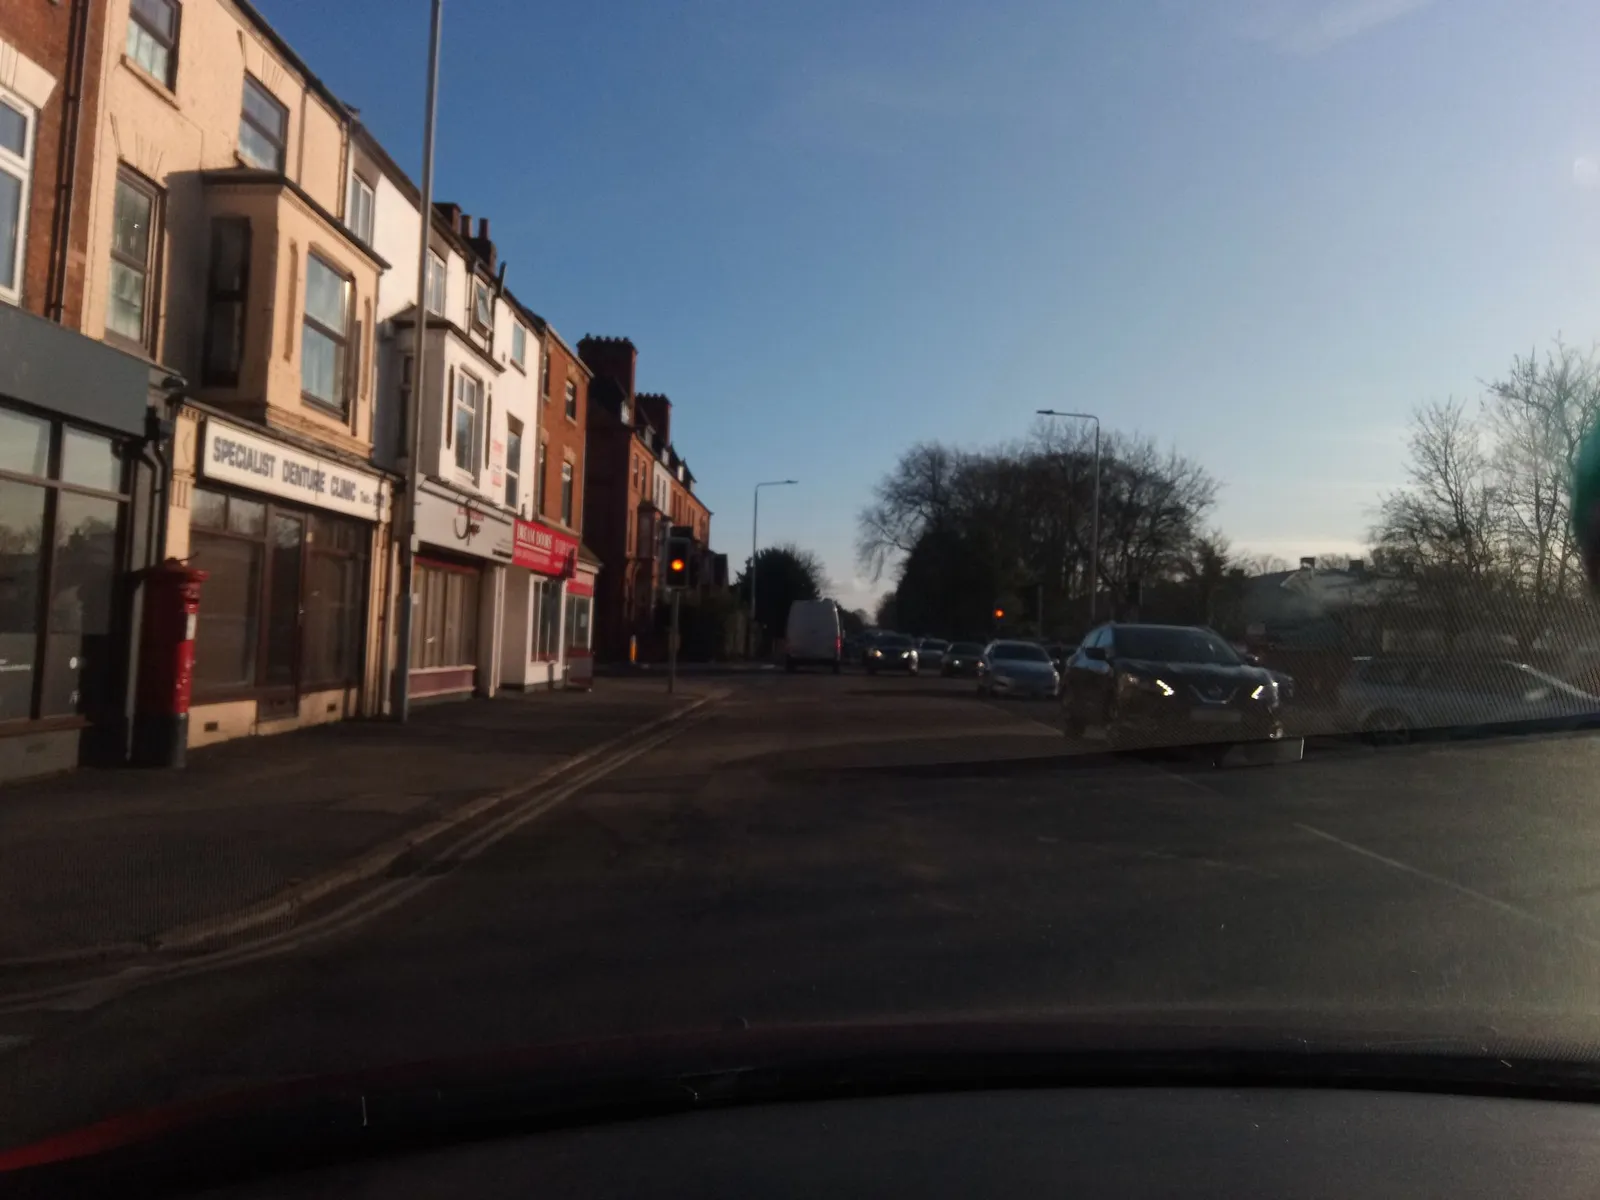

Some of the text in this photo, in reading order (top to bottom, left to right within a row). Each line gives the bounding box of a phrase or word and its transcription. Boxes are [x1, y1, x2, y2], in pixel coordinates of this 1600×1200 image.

[213, 436, 276, 479] SPECIALIST
[282, 459, 326, 494] DENTURE
[331, 476, 356, 502] CLINIC
